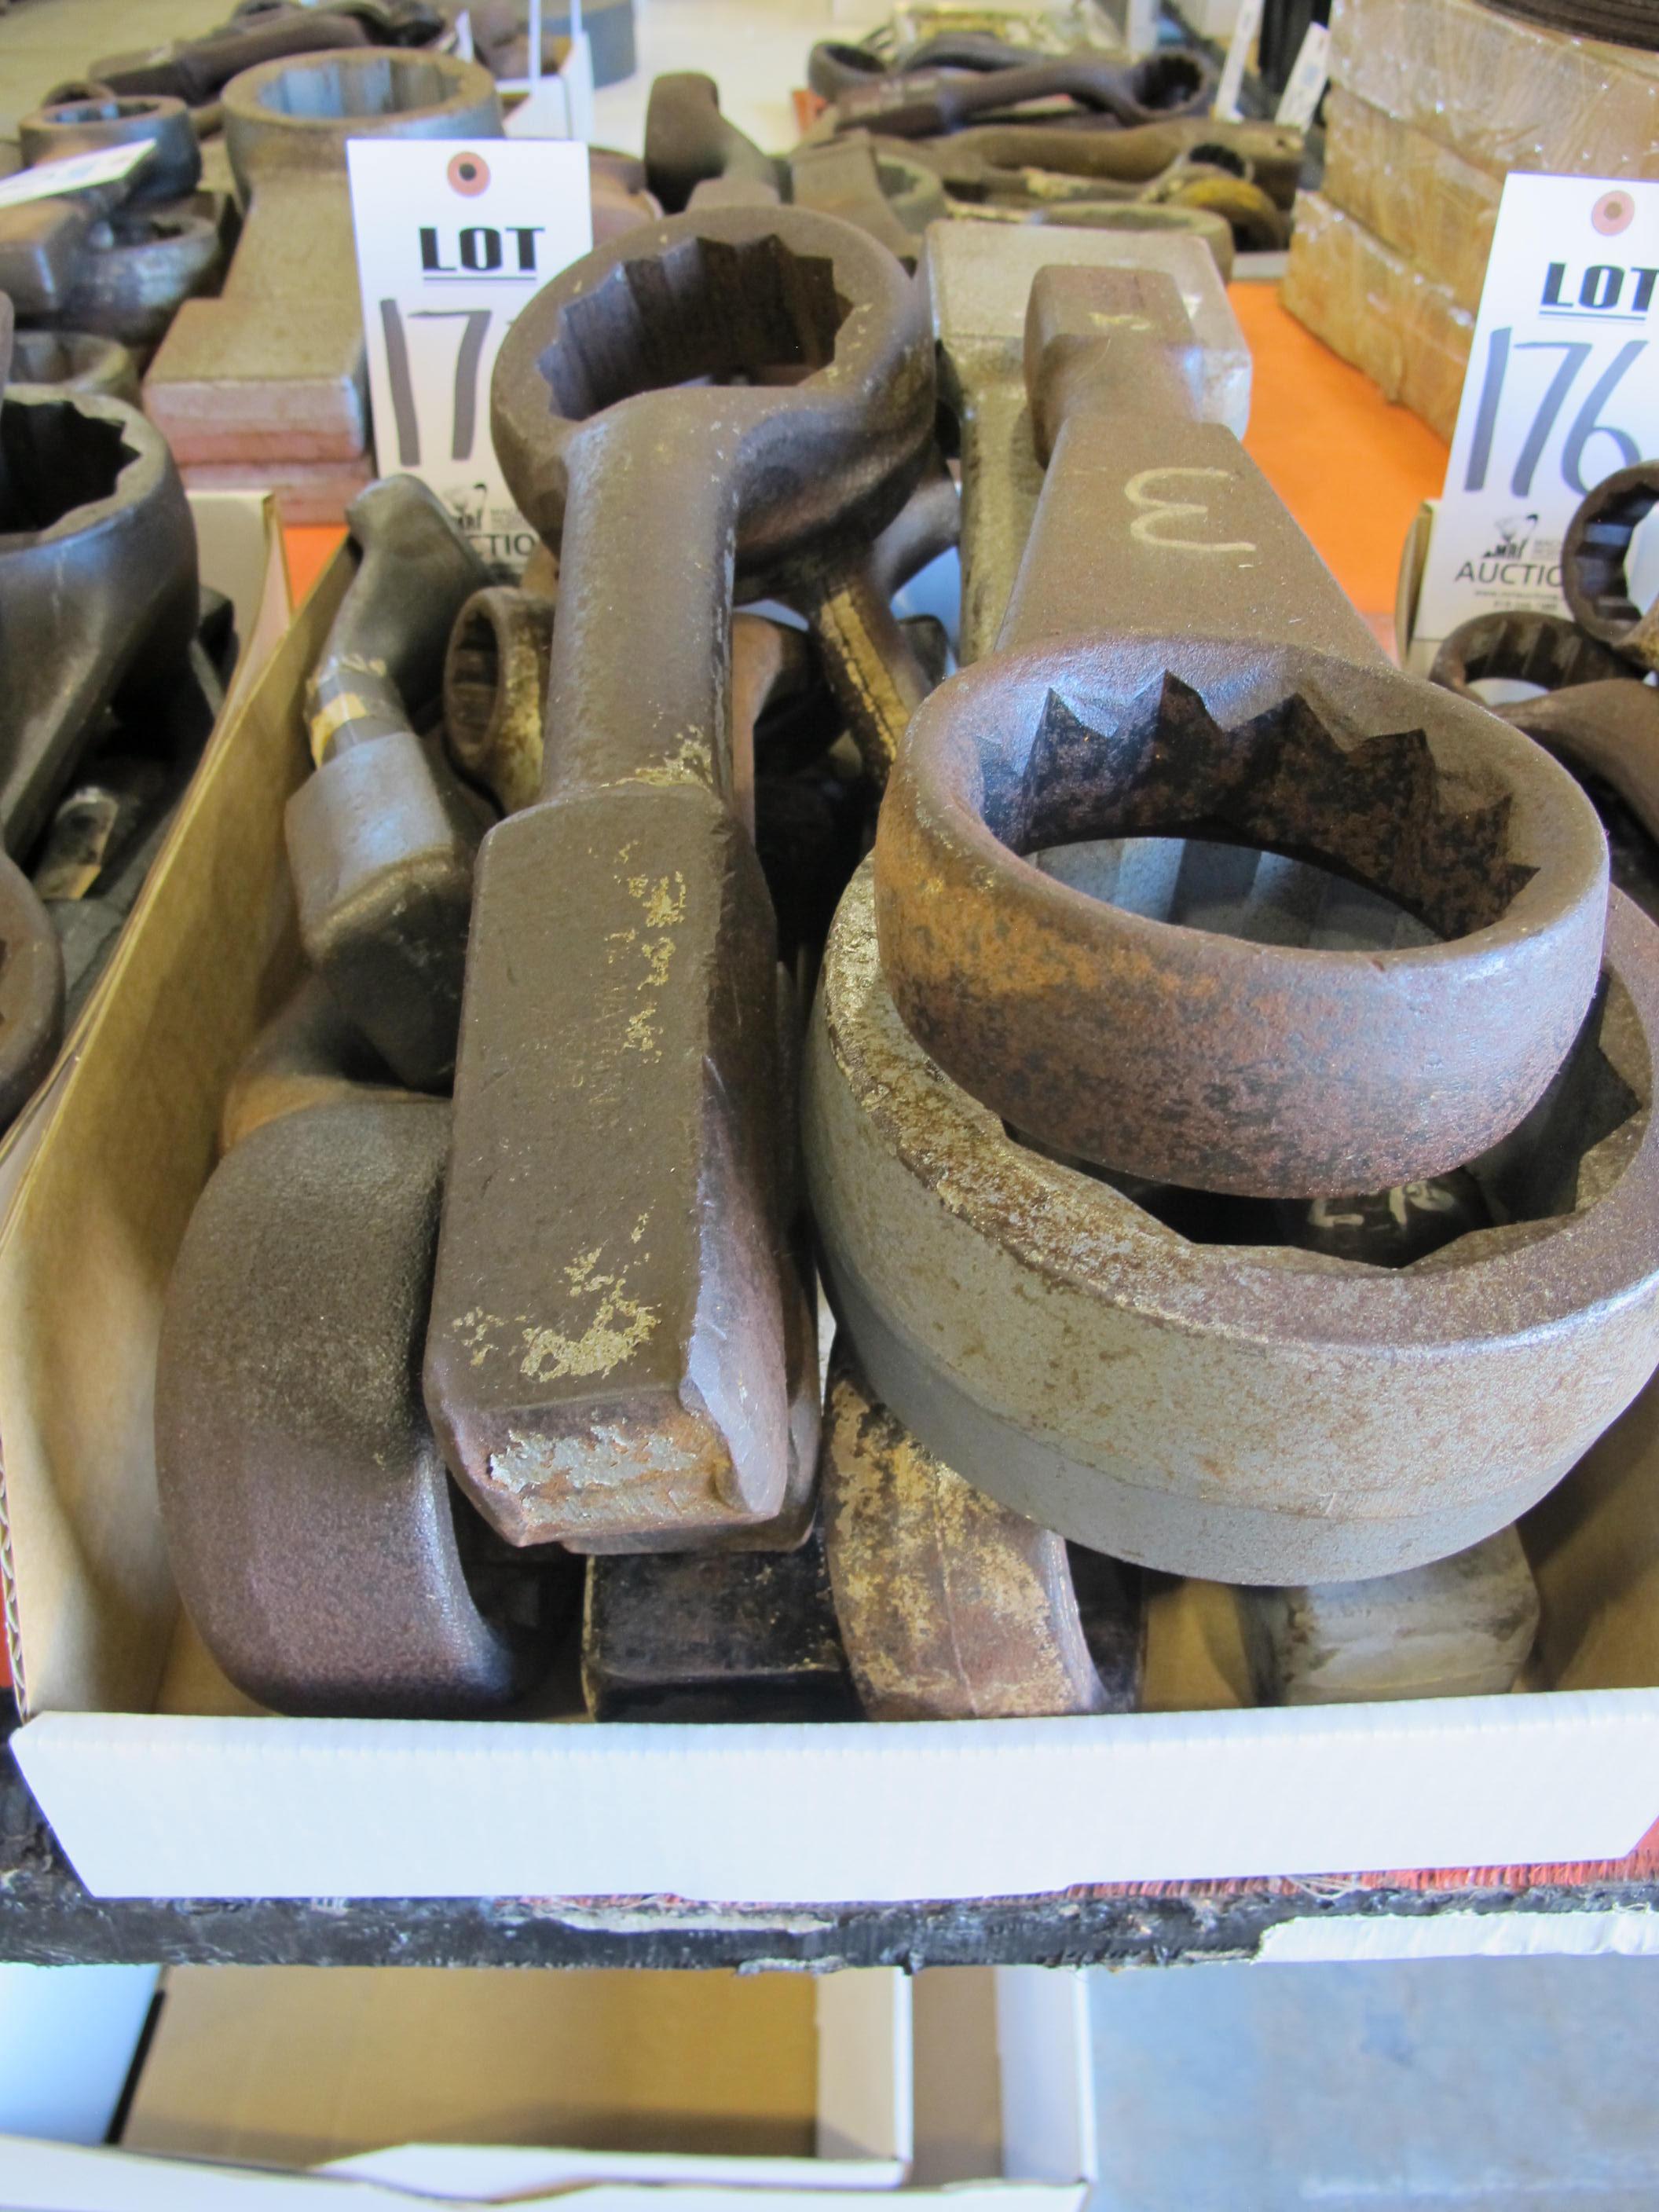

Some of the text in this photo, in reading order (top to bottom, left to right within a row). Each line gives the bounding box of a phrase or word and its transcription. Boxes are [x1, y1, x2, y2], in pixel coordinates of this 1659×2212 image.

[419, 226, 546, 272] LOT
[1540, 262, 1659, 313] LOT
[380, 298, 515, 467] 17
[1463, 326, 1649, 500] 176
[1455, 560, 1562, 588] AUCTIO
